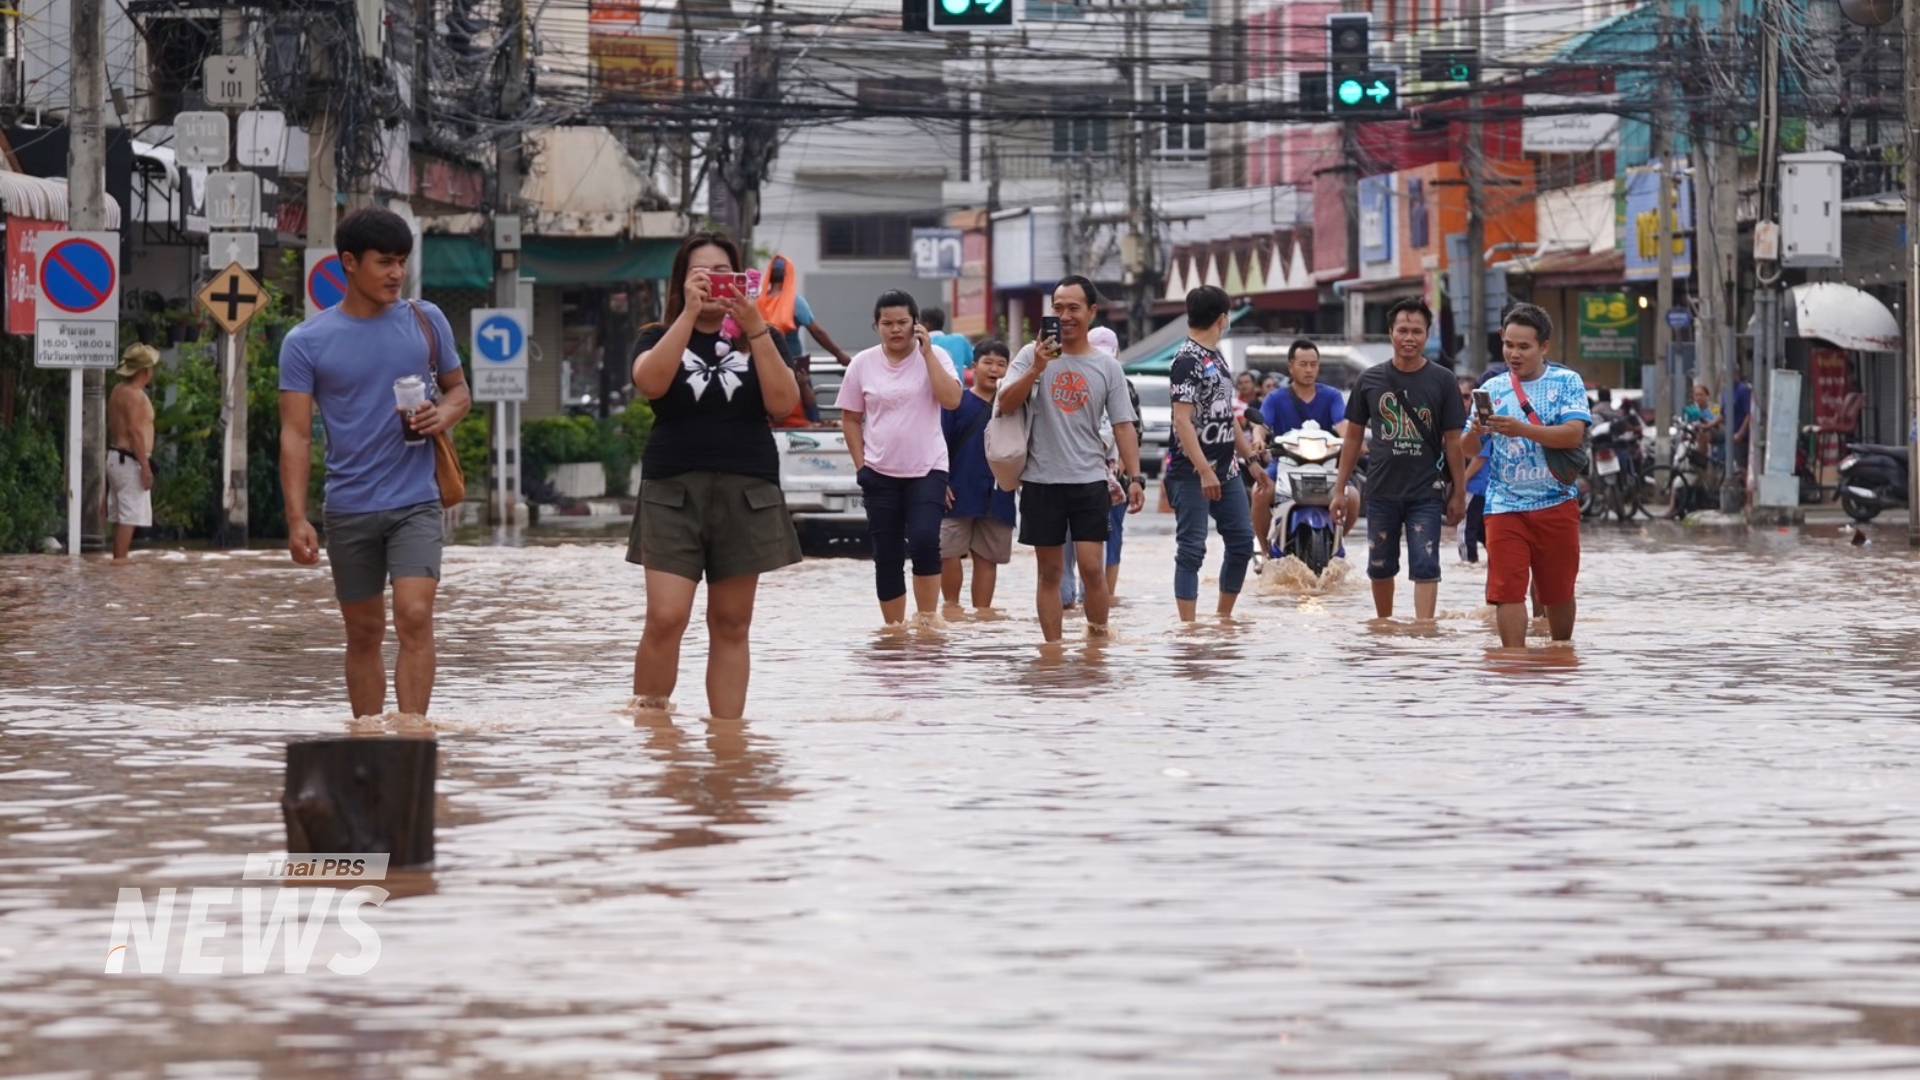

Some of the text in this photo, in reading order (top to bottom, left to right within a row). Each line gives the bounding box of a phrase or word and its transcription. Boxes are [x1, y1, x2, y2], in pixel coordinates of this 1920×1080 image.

[220, 80, 243, 98] 101
[913, 238, 961, 268] ยา
[1586, 301, 1628, 320] PS
